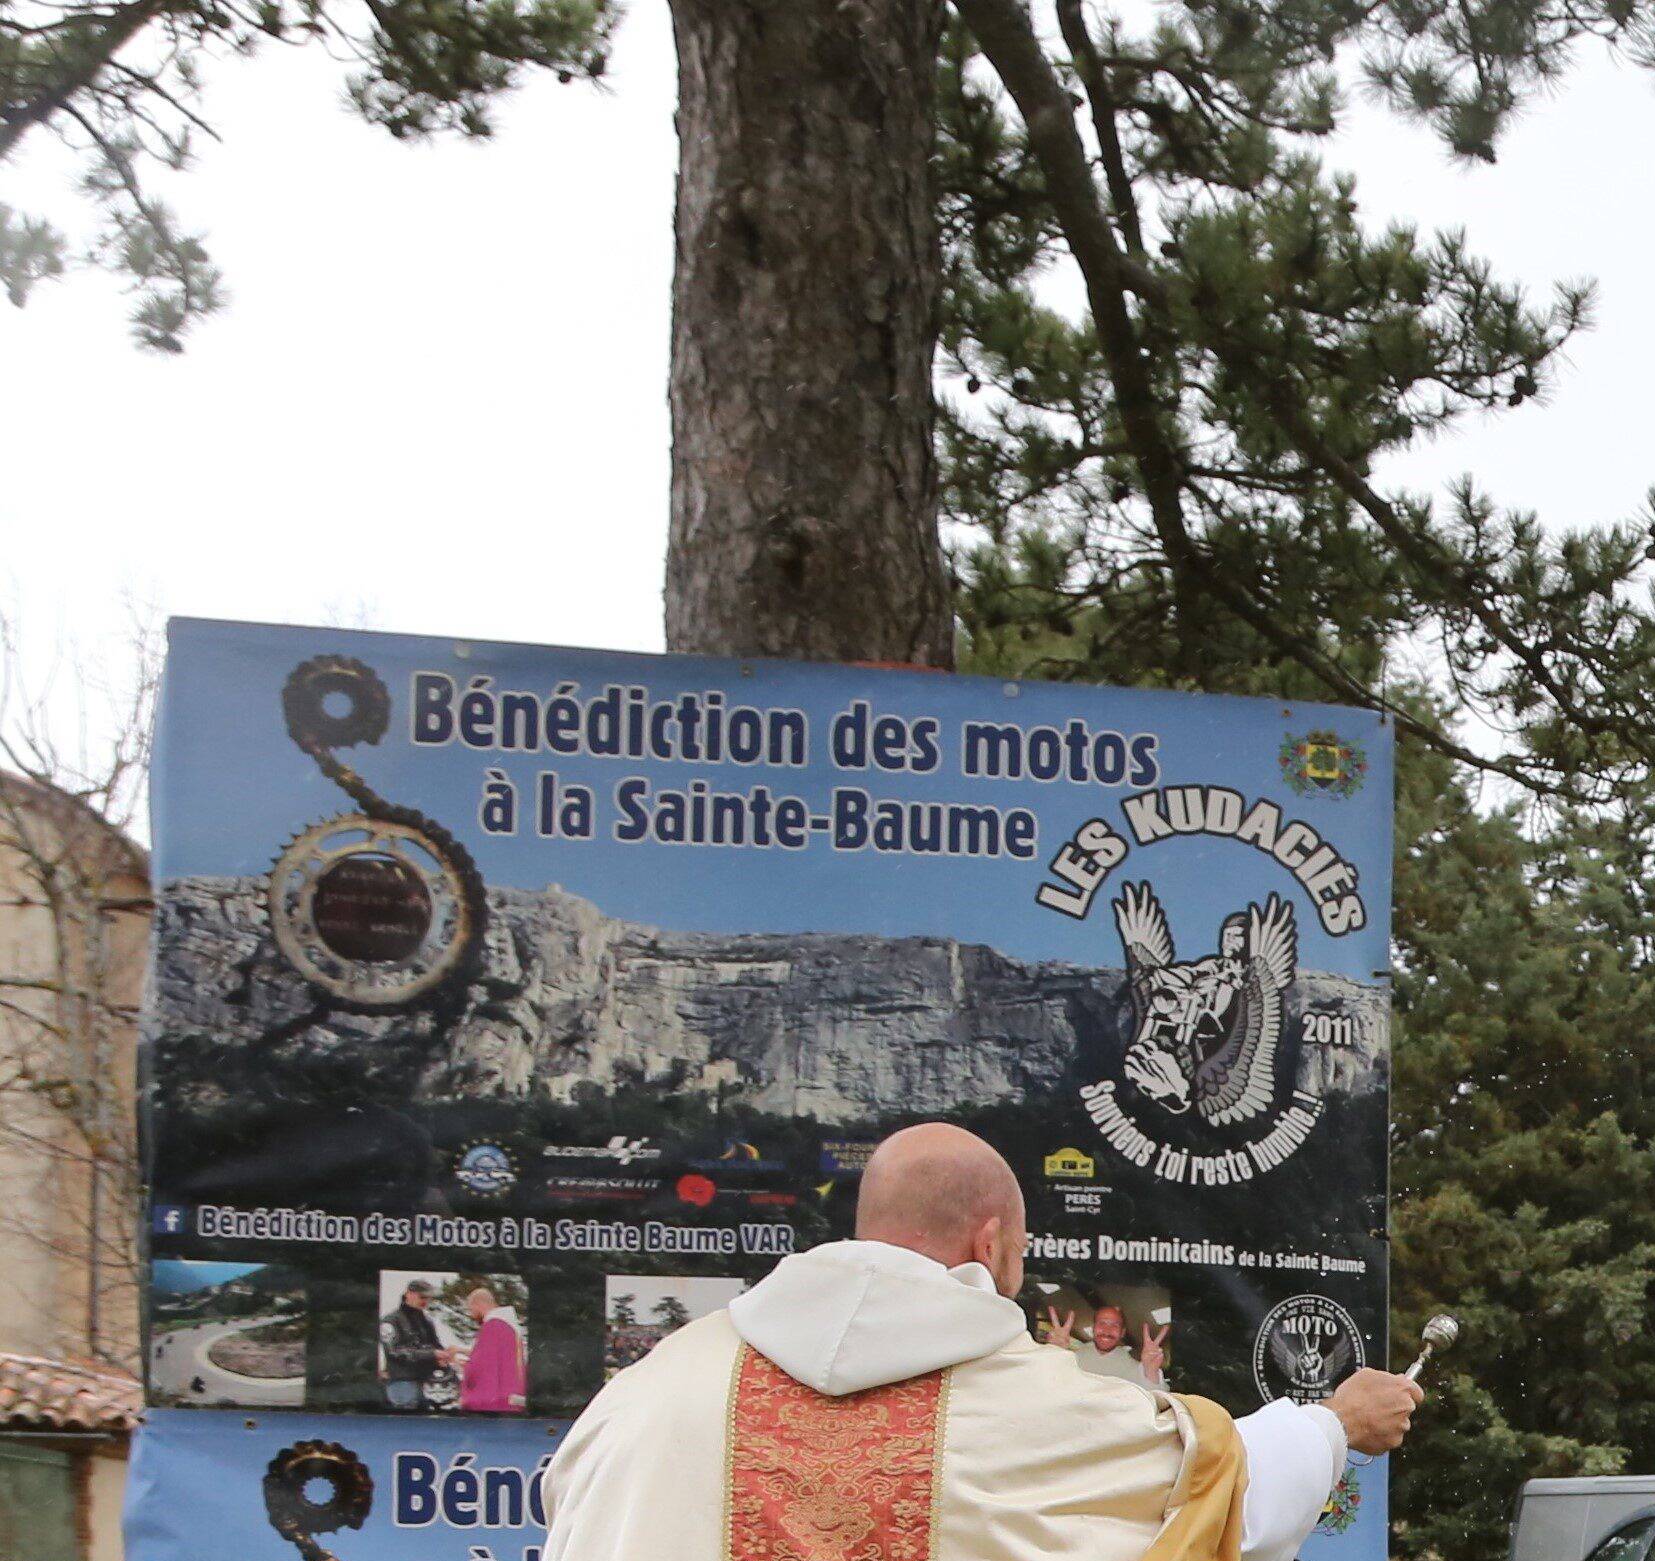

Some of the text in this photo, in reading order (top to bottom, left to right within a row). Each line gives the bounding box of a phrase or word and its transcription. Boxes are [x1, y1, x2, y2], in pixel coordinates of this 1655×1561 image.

[412, 671, 1159, 787] Bénédiction des motos
[480, 767, 1038, 860] à la Sainte-Baume
[1035, 785, 1367, 936] LES KUDACIÉS
[1301, 1012, 1354, 1046] 2011
[1080, 1079, 1155, 1170] Souviens
[1155, 1144, 1189, 1181] toi
[1190, 1149, 1253, 1187] reste
[197, 1206, 796, 1254] Bénédiction des Motos à la Sainte Baume VAR
[1097, 1234, 1235, 1265] Dominicains
[1238, 1251, 1256, 1267] de
[1259, 1252, 1272, 1268] la
[1275, 1253, 1319, 1271] Sainte
[1321, 1256, 1367, 1273] Baume
[1282, 1315, 1338, 1336] MOTO
